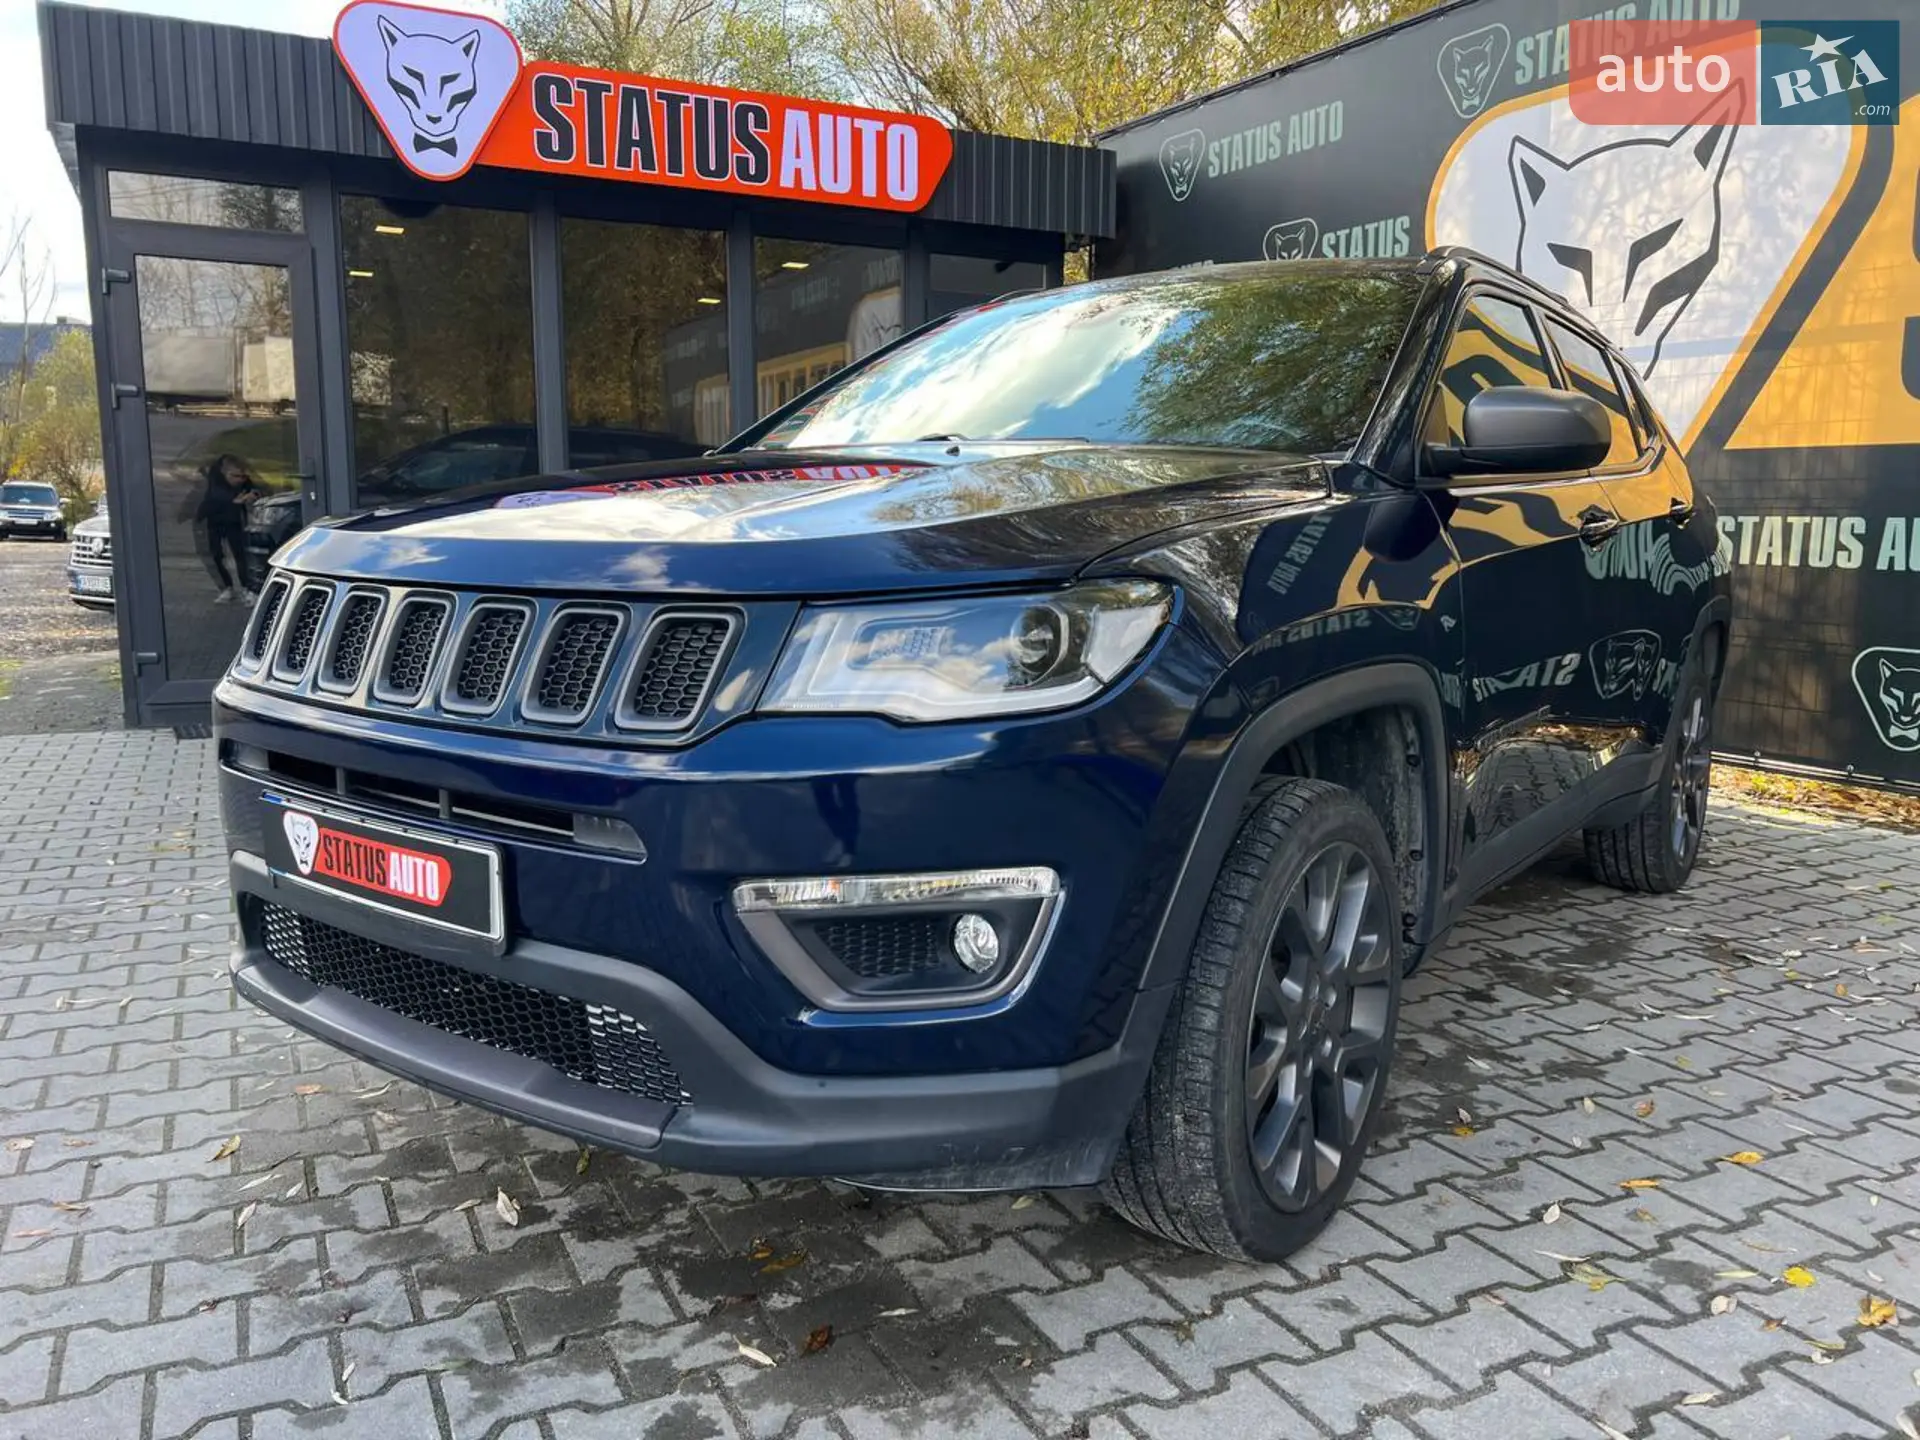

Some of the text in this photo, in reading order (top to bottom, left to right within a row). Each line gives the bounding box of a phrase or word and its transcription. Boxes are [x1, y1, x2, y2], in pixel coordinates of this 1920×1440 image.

[1515, 3, 1637, 86] STATUS
[532, 73, 919, 202] STATUS AUTO
[1208, 100, 1343, 178] STATUS AUTO
[1322, 215, 1410, 259] STATUS
[1717, 515, 1867, 569] STATUS
[323, 833, 440, 902] STATUS AUTO
